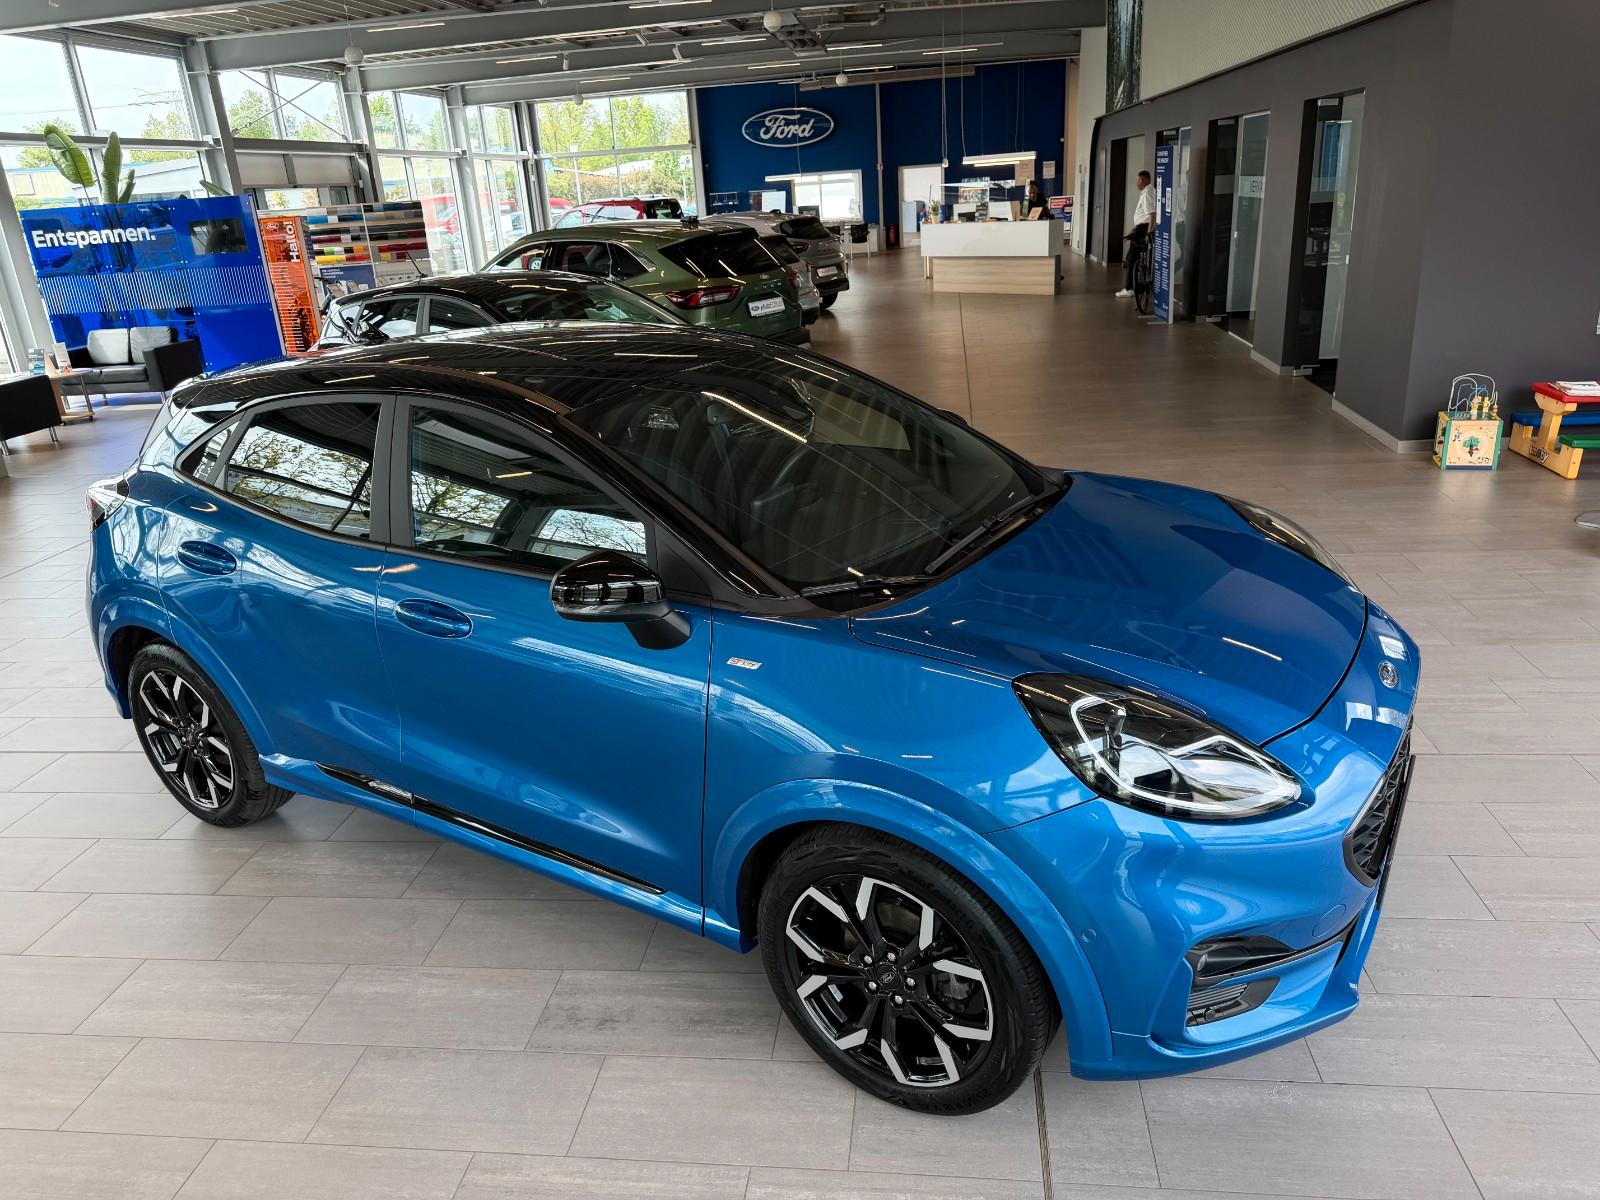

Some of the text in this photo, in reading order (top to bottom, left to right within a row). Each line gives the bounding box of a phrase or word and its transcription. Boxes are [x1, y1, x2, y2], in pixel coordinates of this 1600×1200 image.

[760, 114, 815, 140] Ford
[31, 226, 157, 249] Entspannen.
[282, 220, 301, 263] Hallo!
